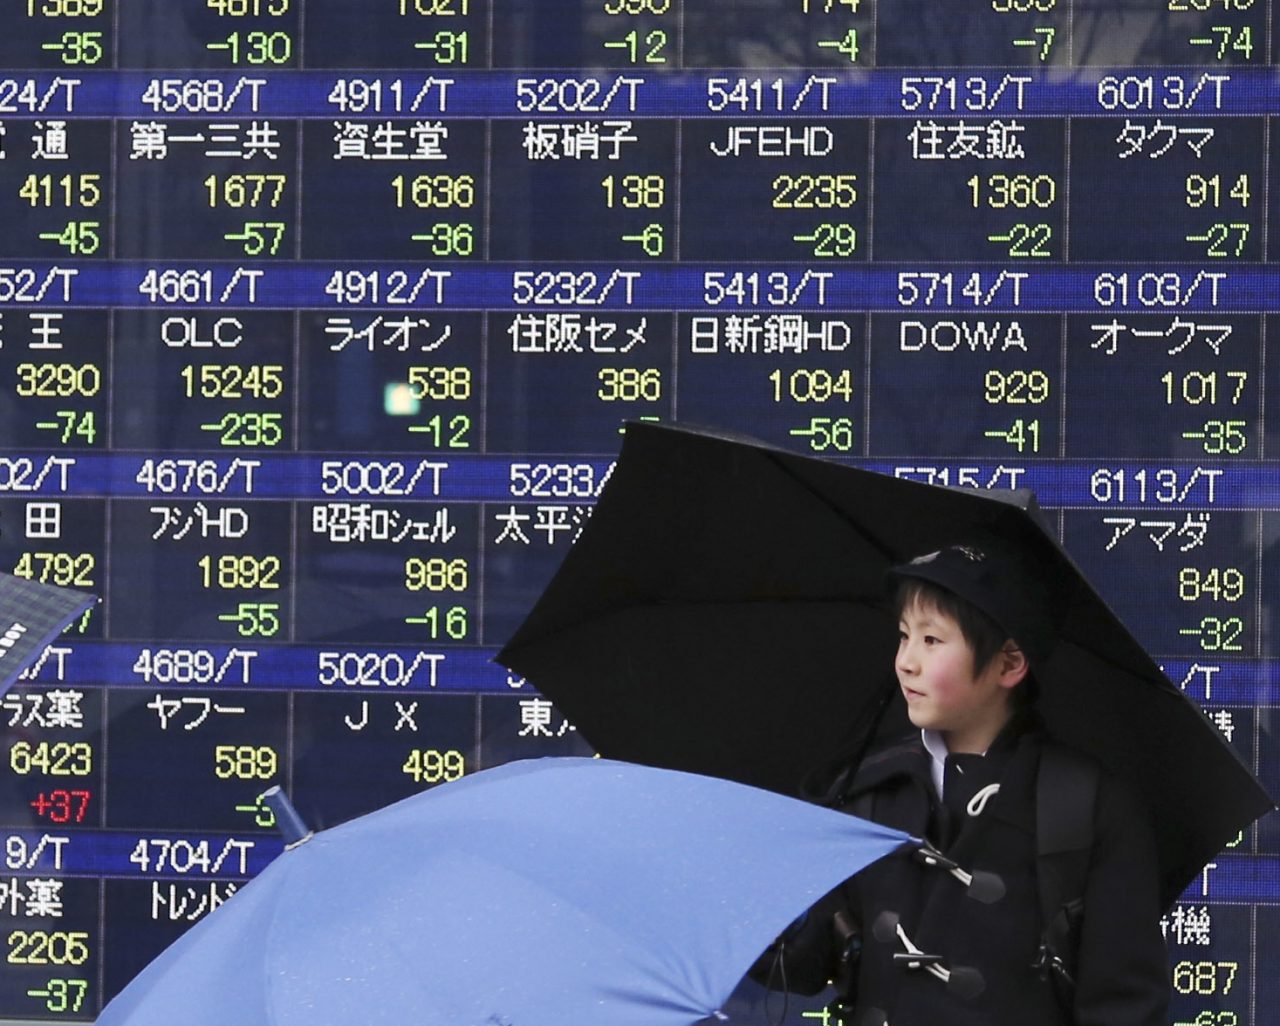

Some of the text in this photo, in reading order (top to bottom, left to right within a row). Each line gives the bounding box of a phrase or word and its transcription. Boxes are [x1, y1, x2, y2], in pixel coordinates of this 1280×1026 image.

[41, 31, 102, 64] -35
[206, 31, 291, 64] -130
[414, 31, 467, 64] -31
[604, 30, 667, 63] -12
[817, 29, 859, 62] -4
[1013, 27, 1055, 61] -7
[1189, 26, 1253, 60] -74
[141, 76, 267, 112] 4568/T
[328, 76, 455, 112] 4911/T
[516, 75, 645, 112] 5202/T
[708, 74, 838, 111] 5411/T
[901, 73, 1032, 111] 5713/T
[1098, 72, 1231, 110] 6013/T
[129, 120, 281, 160] 第一三共
[333, 120, 448, 160] 資生堂
[522, 120, 638, 160] 板硝子
[710, 126, 834, 157] JFEHD
[907, 119, 1026, 159] 住友鉱
[1116, 118, 1215, 159] タクマ
[19, 174, 100, 207] 4115
[204, 174, 286, 208] 1677
[391, 175, 474, 208] 1636
[601, 175, 664, 208] 138
[772, 175, 857, 208] 2235
[967, 174, 1056, 208] 1360
[1186, 174, 1251, 208] 914
[38, 221, 100, 254] -45
[224, 222, 285, 255] -57
[411, 223, 473, 256] -36
[621, 223, 663, 257] -6
[793, 223, 856, 257] -29
[988, 223, 1052, 257] -22
[1185, 223, 1250, 257] -27
[139, 267, 264, 303] 4661/T
[325, 268, 452, 304] 4912/T
[513, 268, 642, 305] 5232/T
[704, 269, 834, 305] 5413/T
[898, 269, 1029, 306] 5714/T
[1094, 269, 1227, 306] 6103/T
[161, 317, 243, 348] OLC
[324, 315, 451, 352] ライオン
[507, 313, 647, 353] 住阪セメ
[691, 314, 851, 354] 日新鋼HD
[900, 321, 1028, 352] DOWA
[1090, 315, 1233, 356] オークマ
[16, 363, 100, 397] 3290
[181, 364, 283, 399] 15245
[407, 366, 471, 401] 538
[598, 368, 661, 401] 386
[769, 369, 853, 403] 1094
[985, 370, 1049, 404] 929
[1161, 371, 1247, 405] 1017
[35, 411, 96, 444] -74
[200, 412, 282, 446] -235
[408, 414, 470, 448] -12
[789, 417, 853, 451] -56
[984, 419, 1039, 453] -41
[1182, 420, 1246, 454] -35
[136, 457, 261, 493] 4676/T
[322, 459, 449, 496] 5002/T
[1090, 466, 1224, 503] 6113/T
[150, 501, 249, 540] フジHD
[312, 503, 456, 544] 昭和シェル
[1102, 512, 1211, 552] アマダ
[13, 552, 95, 586] 4792
[198, 555, 280, 589] 1892
[405, 558, 468, 592] 986
[1179, 567, 1244, 602] 849
[218, 603, 279, 636] -55
[405, 606, 467, 639] -16
[1179, 617, 1243, 651] -32
[132, 647, 258, 684] 4689/T
[318, 651, 446, 687] 5020/T
[146, 693, 246, 730] ヤフー
[518, 697, 577, 737] 東
[10, 741, 92, 776] 6423
[215, 745, 277, 779] 589
[402, 748, 465, 783] 499
[31, 789, 91, 823] +37
[130, 838, 255, 874] 4704/T
[7, 930, 89, 965] 2205
[1173, 960, 1238, 995] 687
[27, 979, 88, 1012] -37
